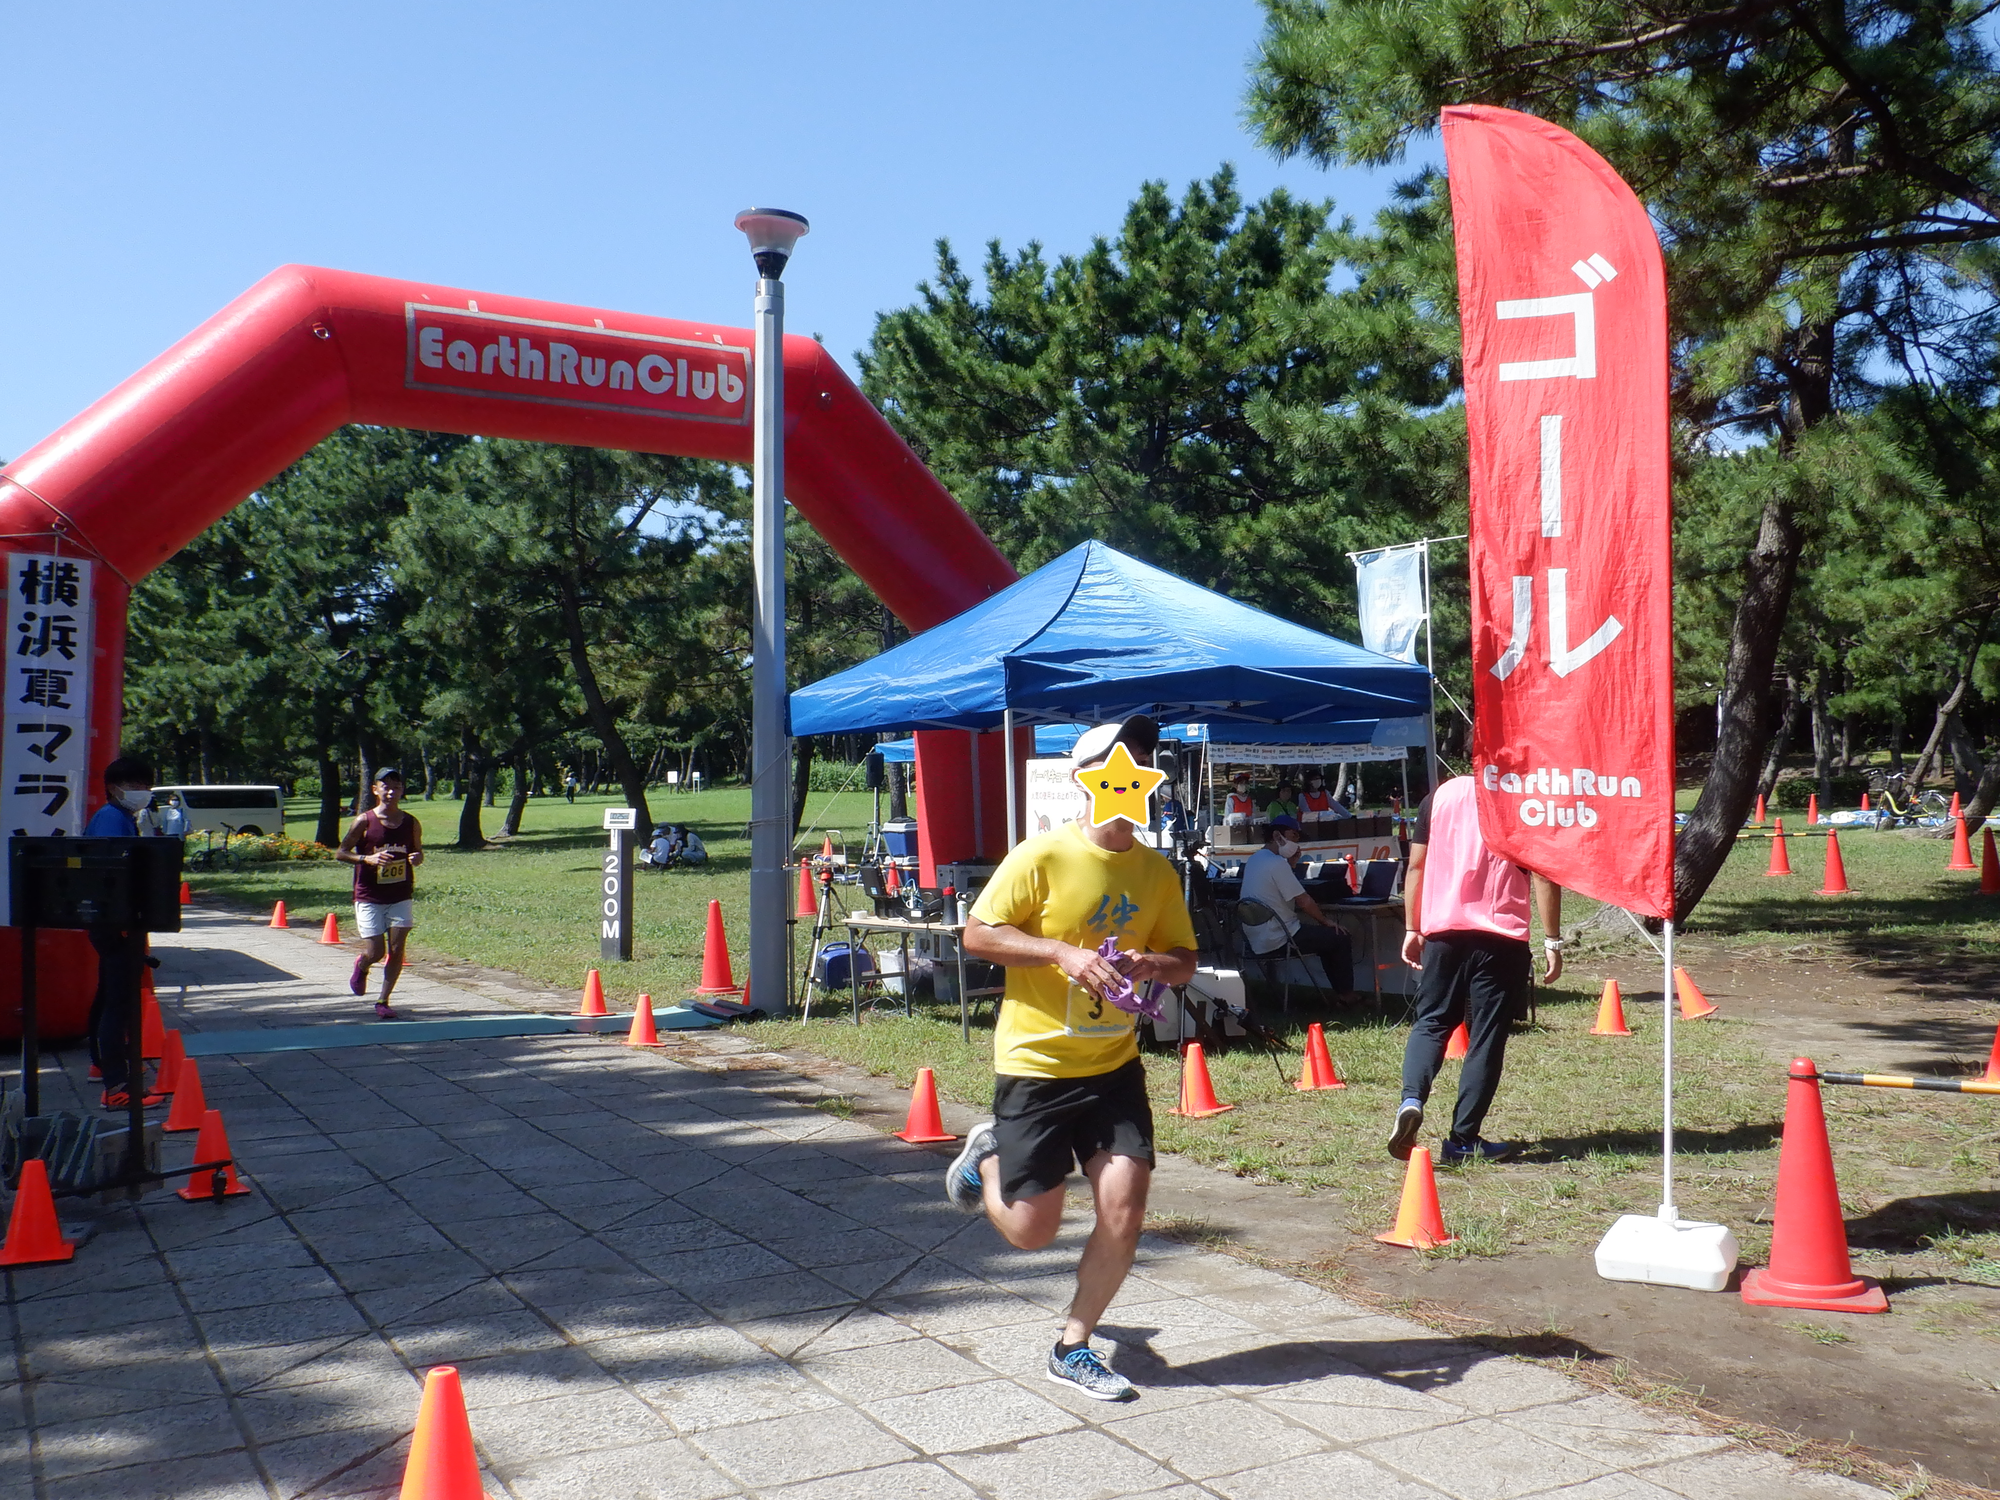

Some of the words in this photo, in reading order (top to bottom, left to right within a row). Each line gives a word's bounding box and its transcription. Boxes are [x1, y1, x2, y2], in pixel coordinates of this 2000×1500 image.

[418, 326, 744, 403] EarthRunClub
[1489, 253, 1623, 680] ゴール
[13, 559, 80, 836] 横浜夏マラ
[1483, 764, 1642, 798] EarthRun
[1519, 798, 1598, 828] Club
[602, 855, 620, 939] 200M
